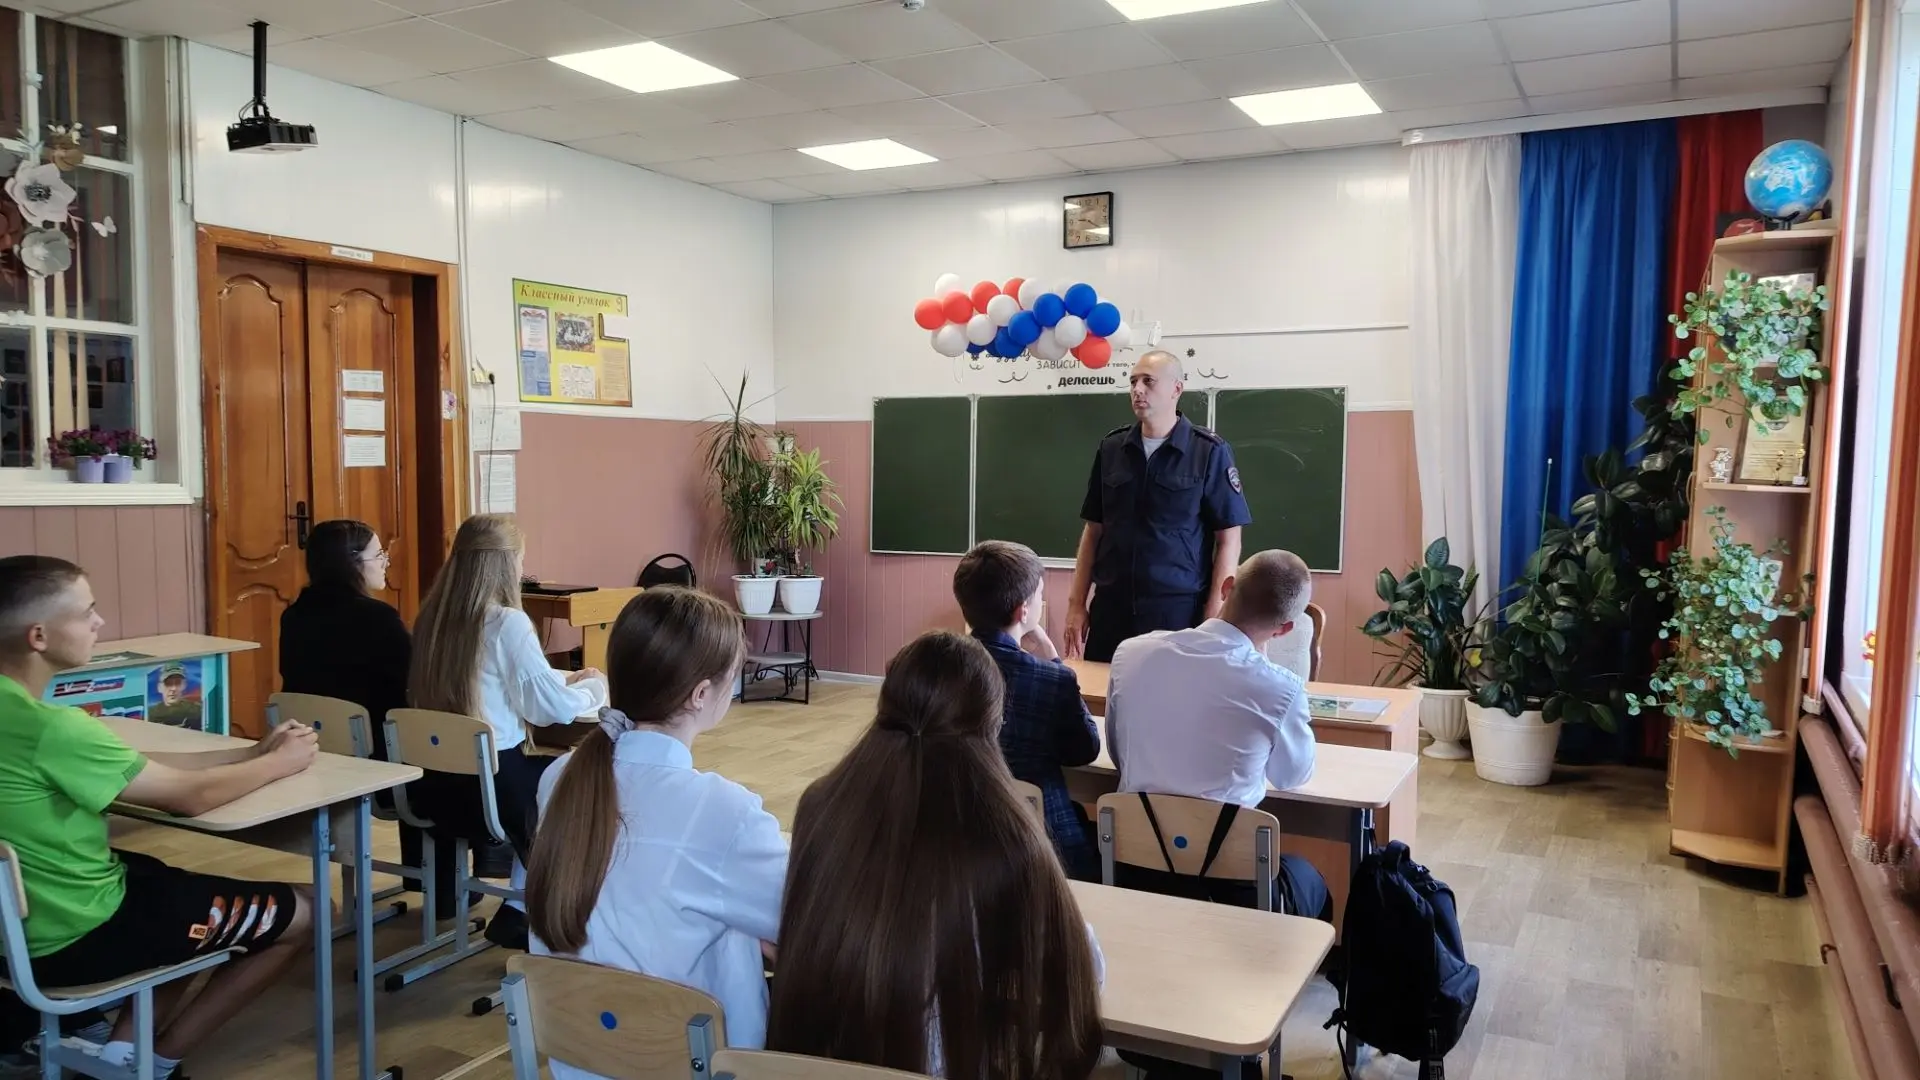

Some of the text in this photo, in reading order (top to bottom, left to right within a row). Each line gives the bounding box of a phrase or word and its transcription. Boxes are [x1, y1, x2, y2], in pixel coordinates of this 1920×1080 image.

[520, 284, 575, 304] Классный
[577, 294, 610, 308] уголок
[1036, 359, 1081, 370] ЗАВИСИТ
[1058, 374, 1115, 387] делаешь
